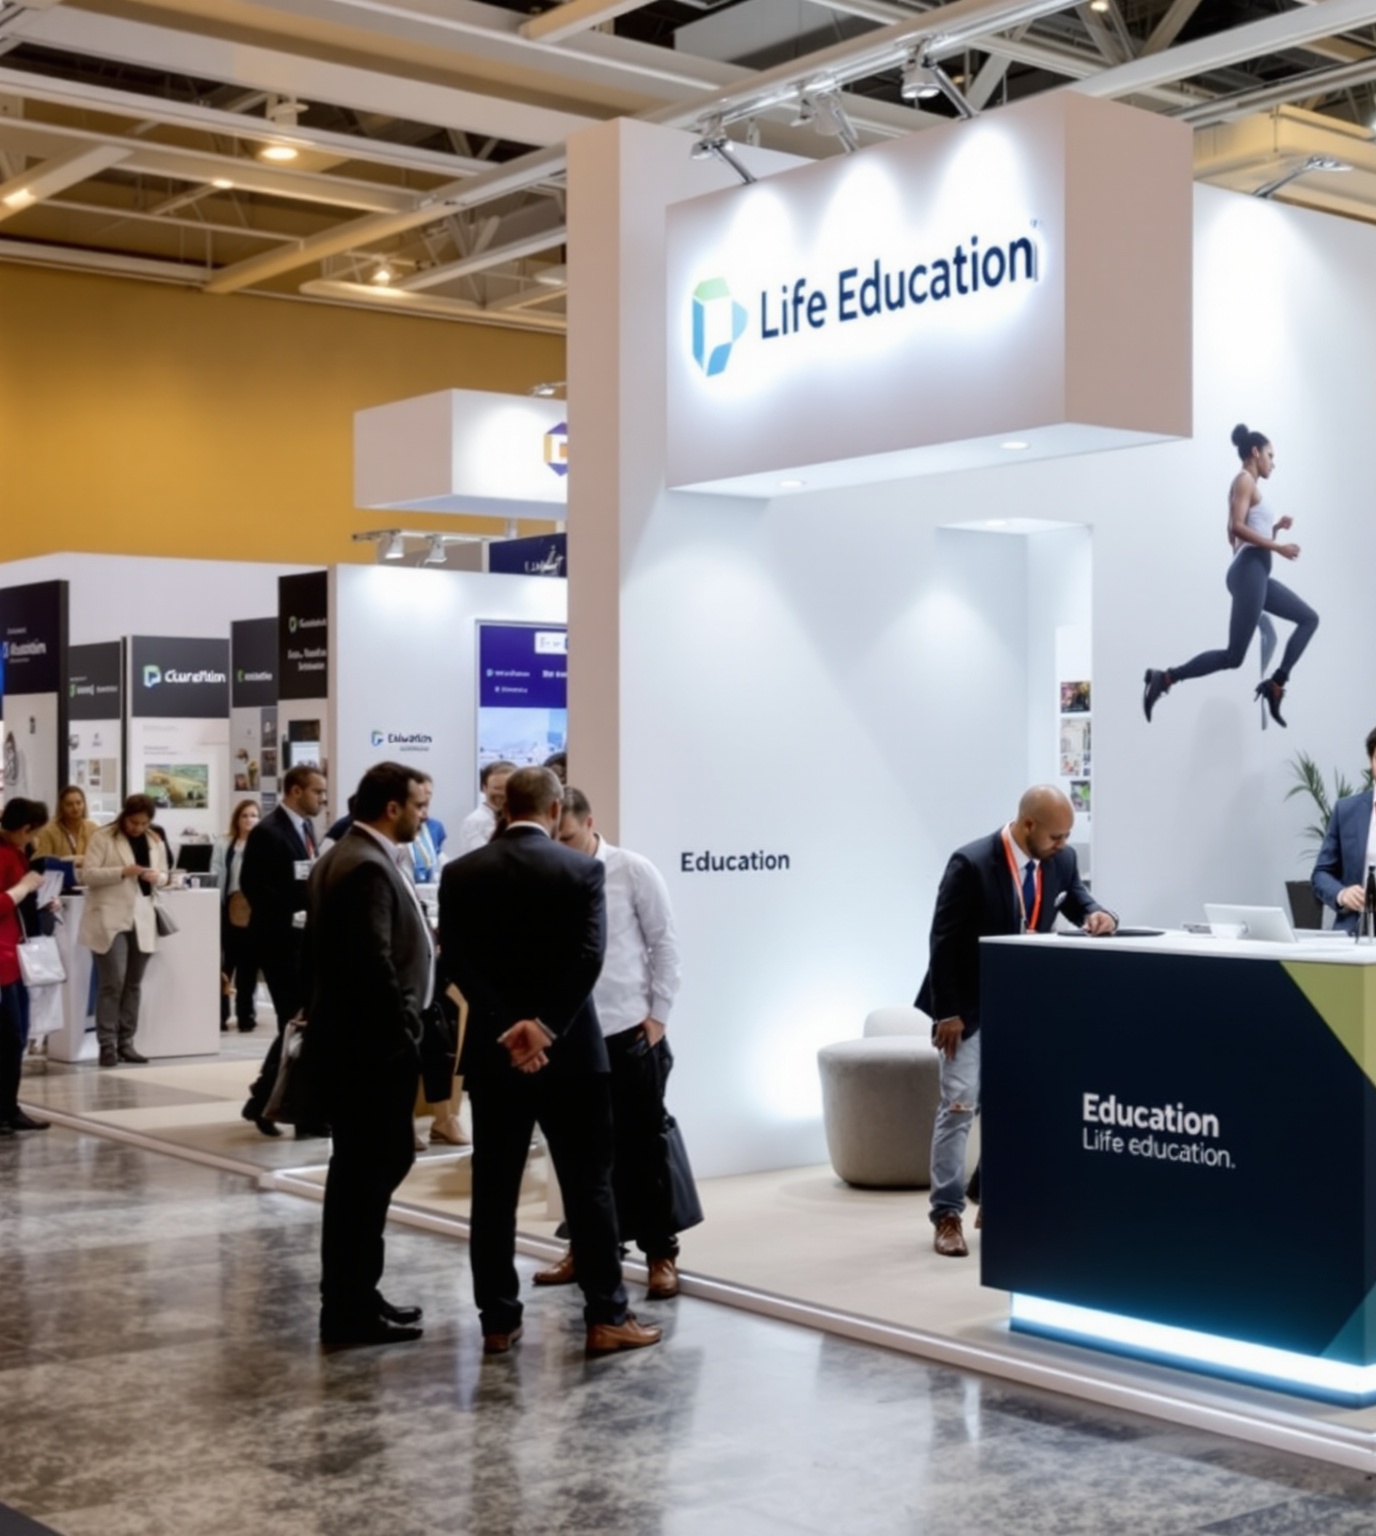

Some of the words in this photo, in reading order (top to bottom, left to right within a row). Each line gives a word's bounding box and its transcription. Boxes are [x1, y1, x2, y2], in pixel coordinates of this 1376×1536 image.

[761, 278, 827, 340] Life
[838, 234, 1034, 322] Education
[681, 850, 790, 872] Education
[1082, 1092, 1220, 1138] Education
[1128, 1134, 1236, 1169] education.
